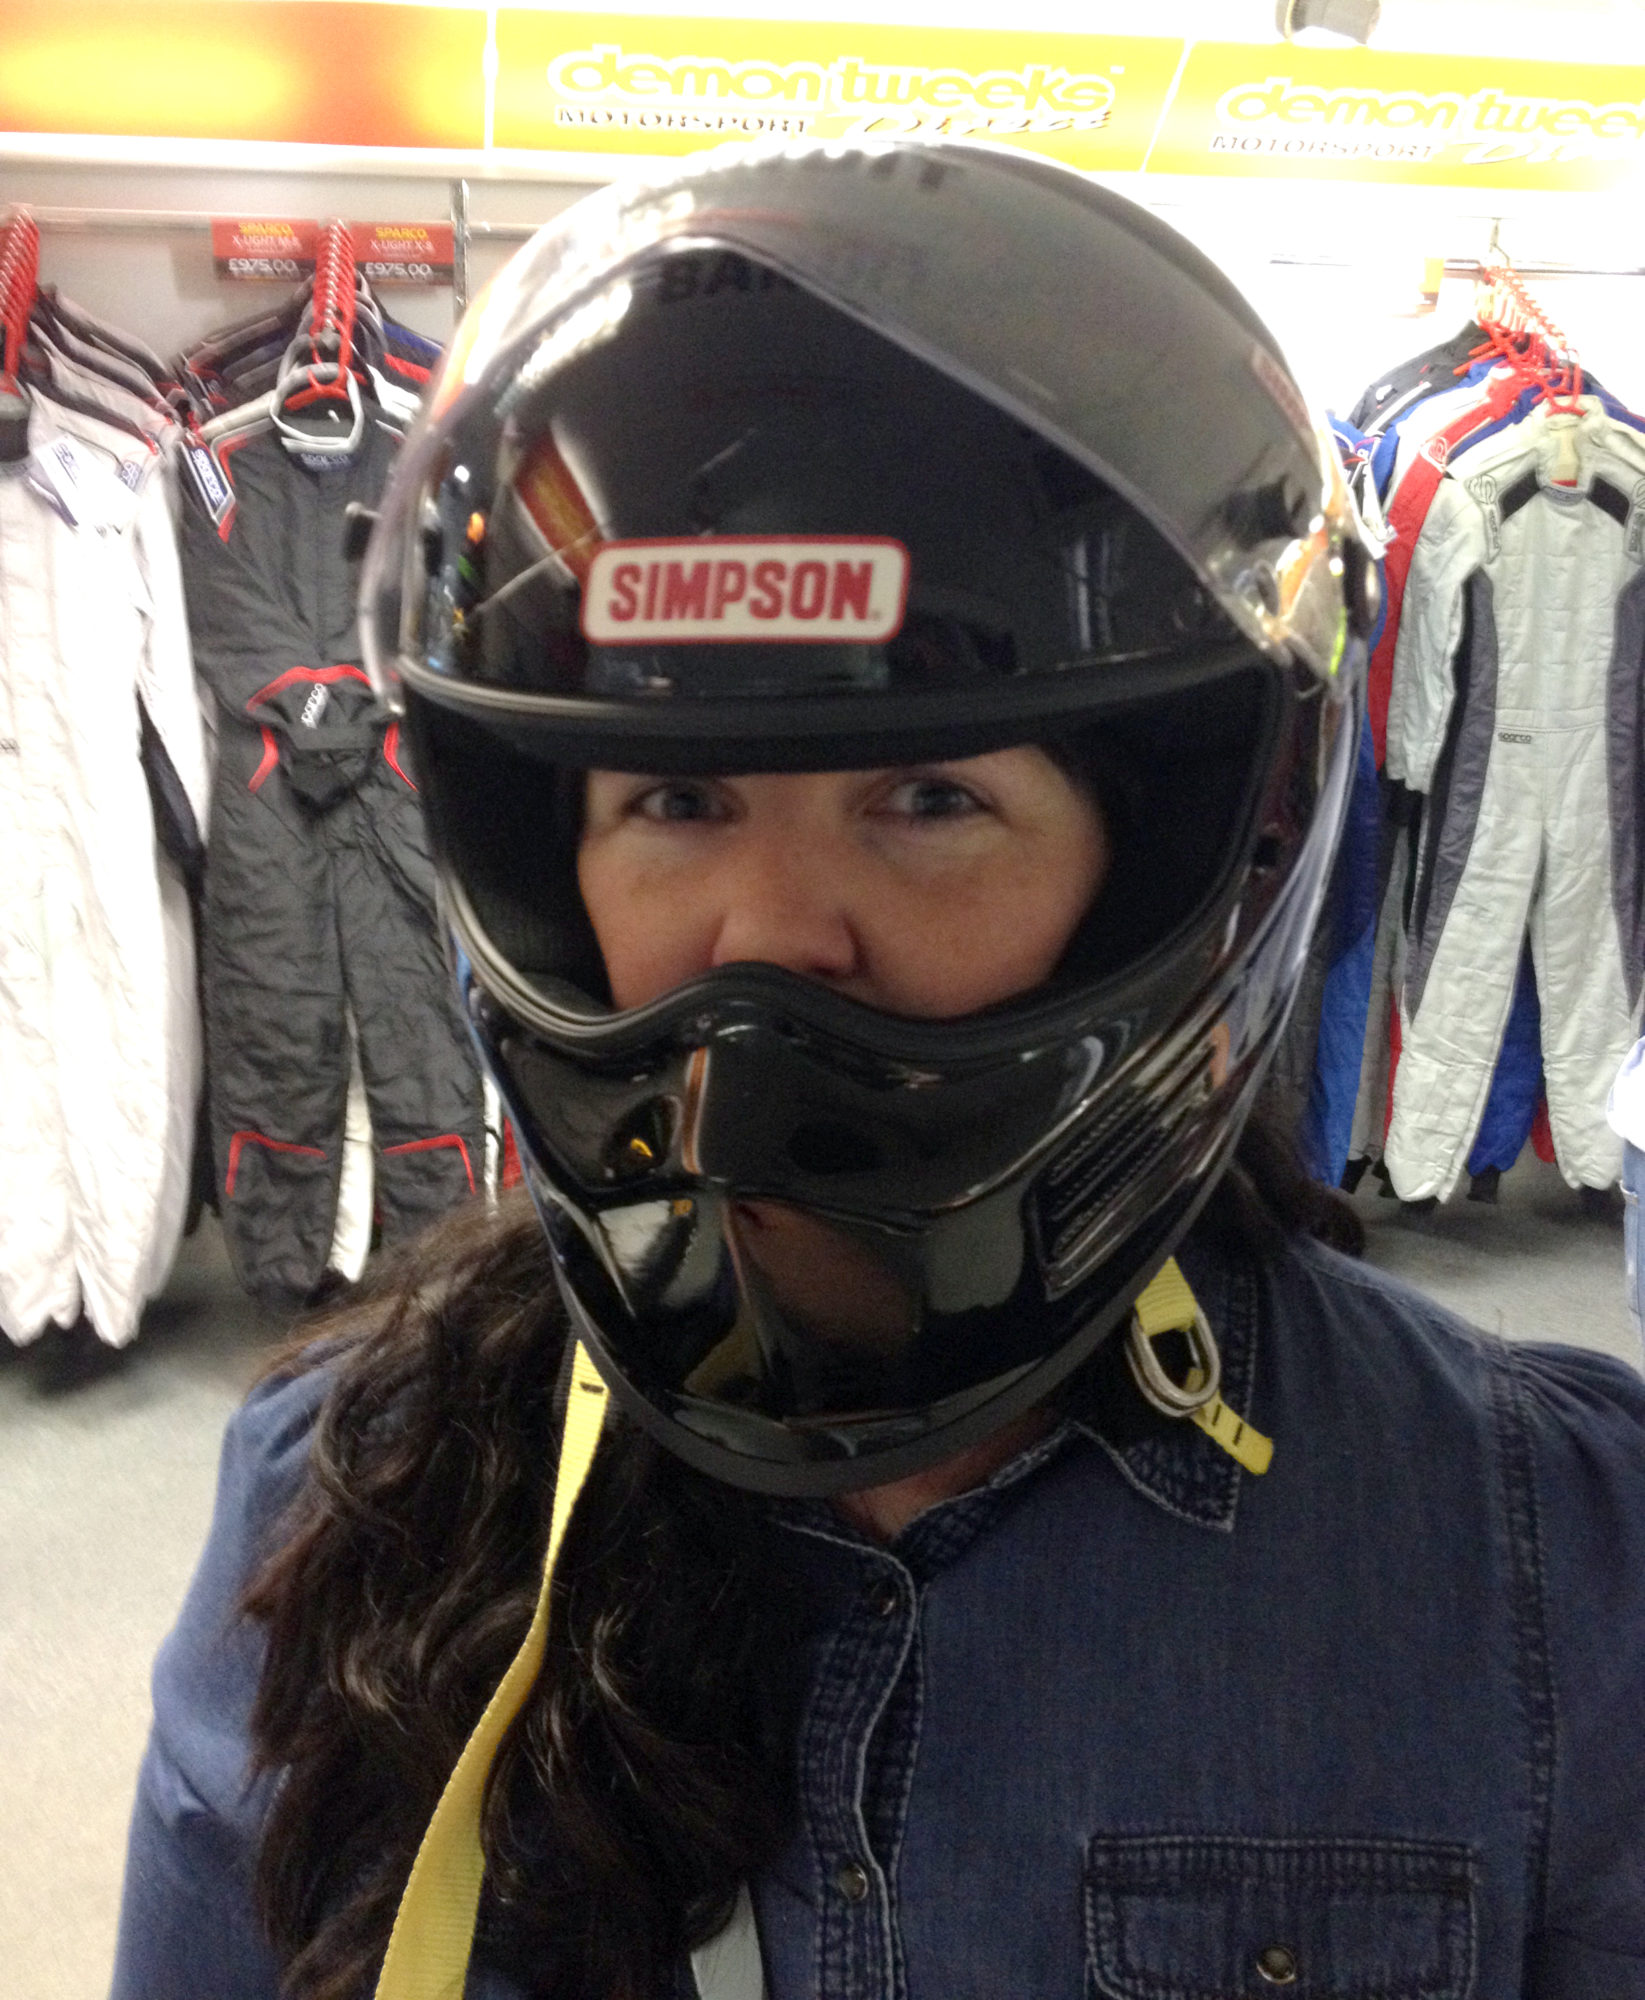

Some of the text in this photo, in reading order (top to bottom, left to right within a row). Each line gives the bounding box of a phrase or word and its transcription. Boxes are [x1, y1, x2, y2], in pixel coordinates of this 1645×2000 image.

[556, 106, 811, 134] MOTORSPORT
[1211, 136, 1437, 159] MOTORSPORT
[375, 227, 428, 240] SPARCO
[370, 240, 412, 254] X-LIGHT
[229, 258, 299, 276] £975.00
[365, 262, 433, 280] £975.00
[608, 559, 874, 622] SIMPSON
